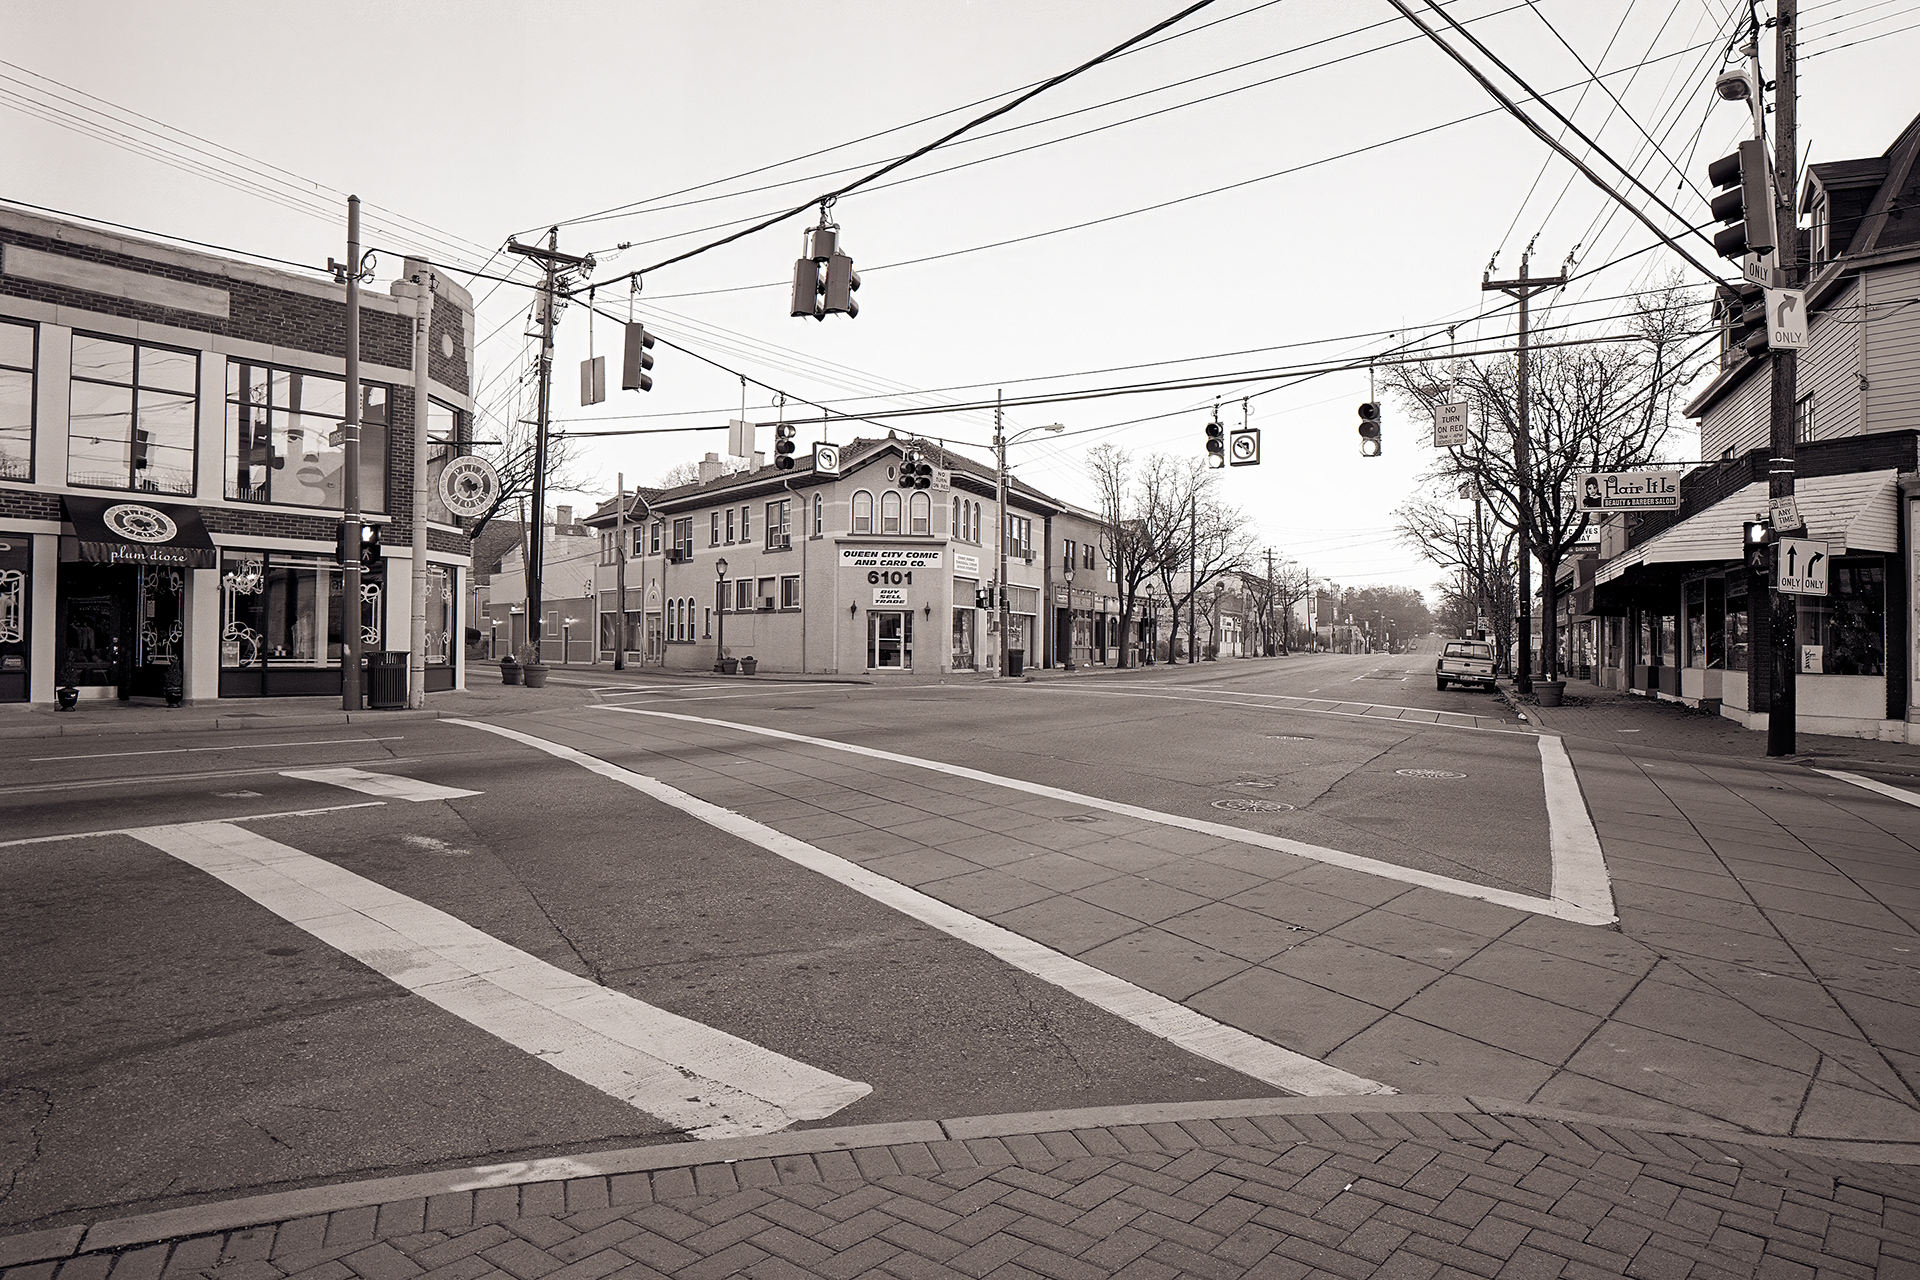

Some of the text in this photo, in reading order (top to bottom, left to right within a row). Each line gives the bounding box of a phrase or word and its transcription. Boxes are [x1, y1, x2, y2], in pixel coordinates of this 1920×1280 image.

[1749, 263, 1768, 281] ONLY
[1775, 331, 1802, 343] ONLY
[1445, 406, 1456, 414] NO
[1442, 415, 1460, 423] TURN
[454, 465, 487, 478] PLUM
[1604, 475, 1676, 498] Hair It Is
[451, 492, 489, 508] DIORE
[119, 510, 157, 520] PLUM
[1778, 508, 1791, 517] ANY
[1778, 515, 1795, 524] TIME
[122, 527, 167, 538] DIORE
[111, 545, 187, 563] plum diore
[867, 570, 913, 585] 6101
[1781, 577, 1824, 589] ONLY ONLY
